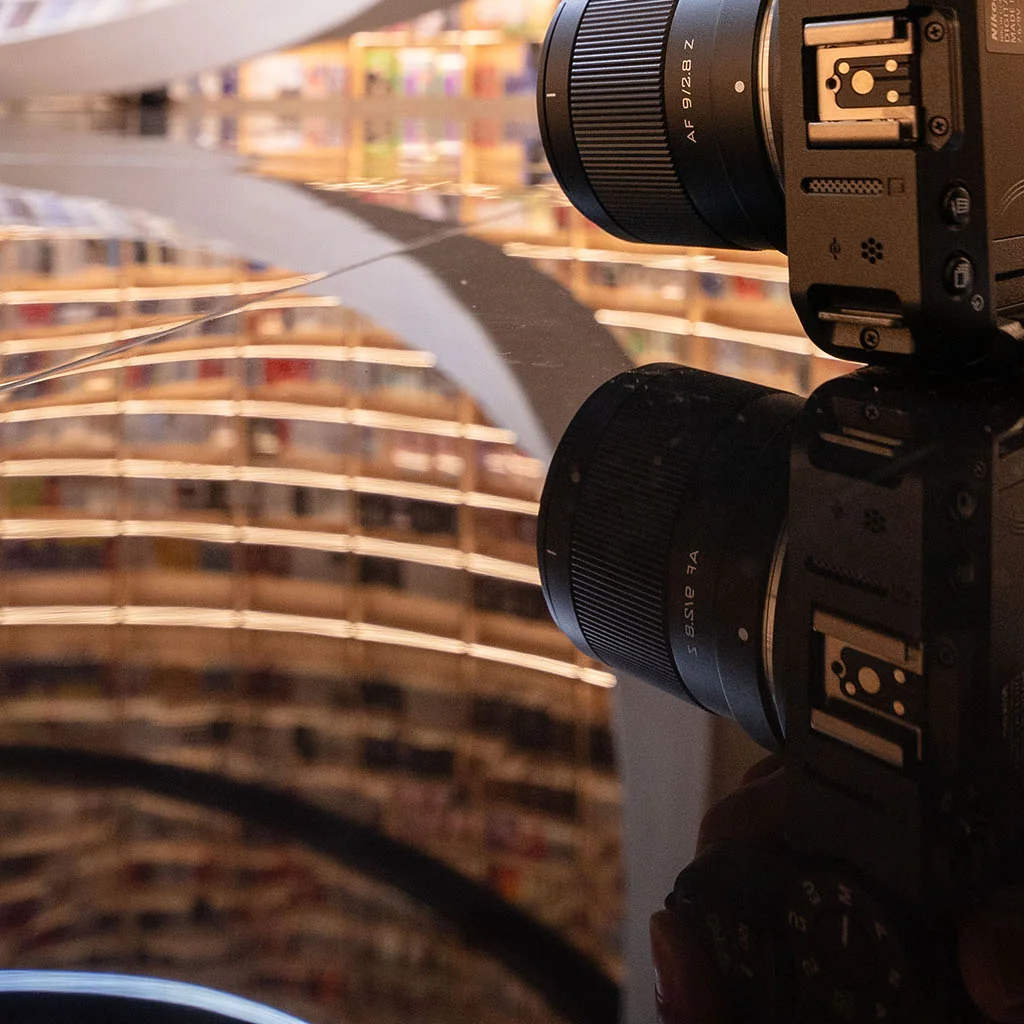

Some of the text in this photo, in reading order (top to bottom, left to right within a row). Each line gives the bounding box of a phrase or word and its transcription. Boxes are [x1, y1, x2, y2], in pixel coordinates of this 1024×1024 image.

[1009, 8, 1017, 43] MADE
[681, 38, 698, 143] AF 9/2.8 Z
